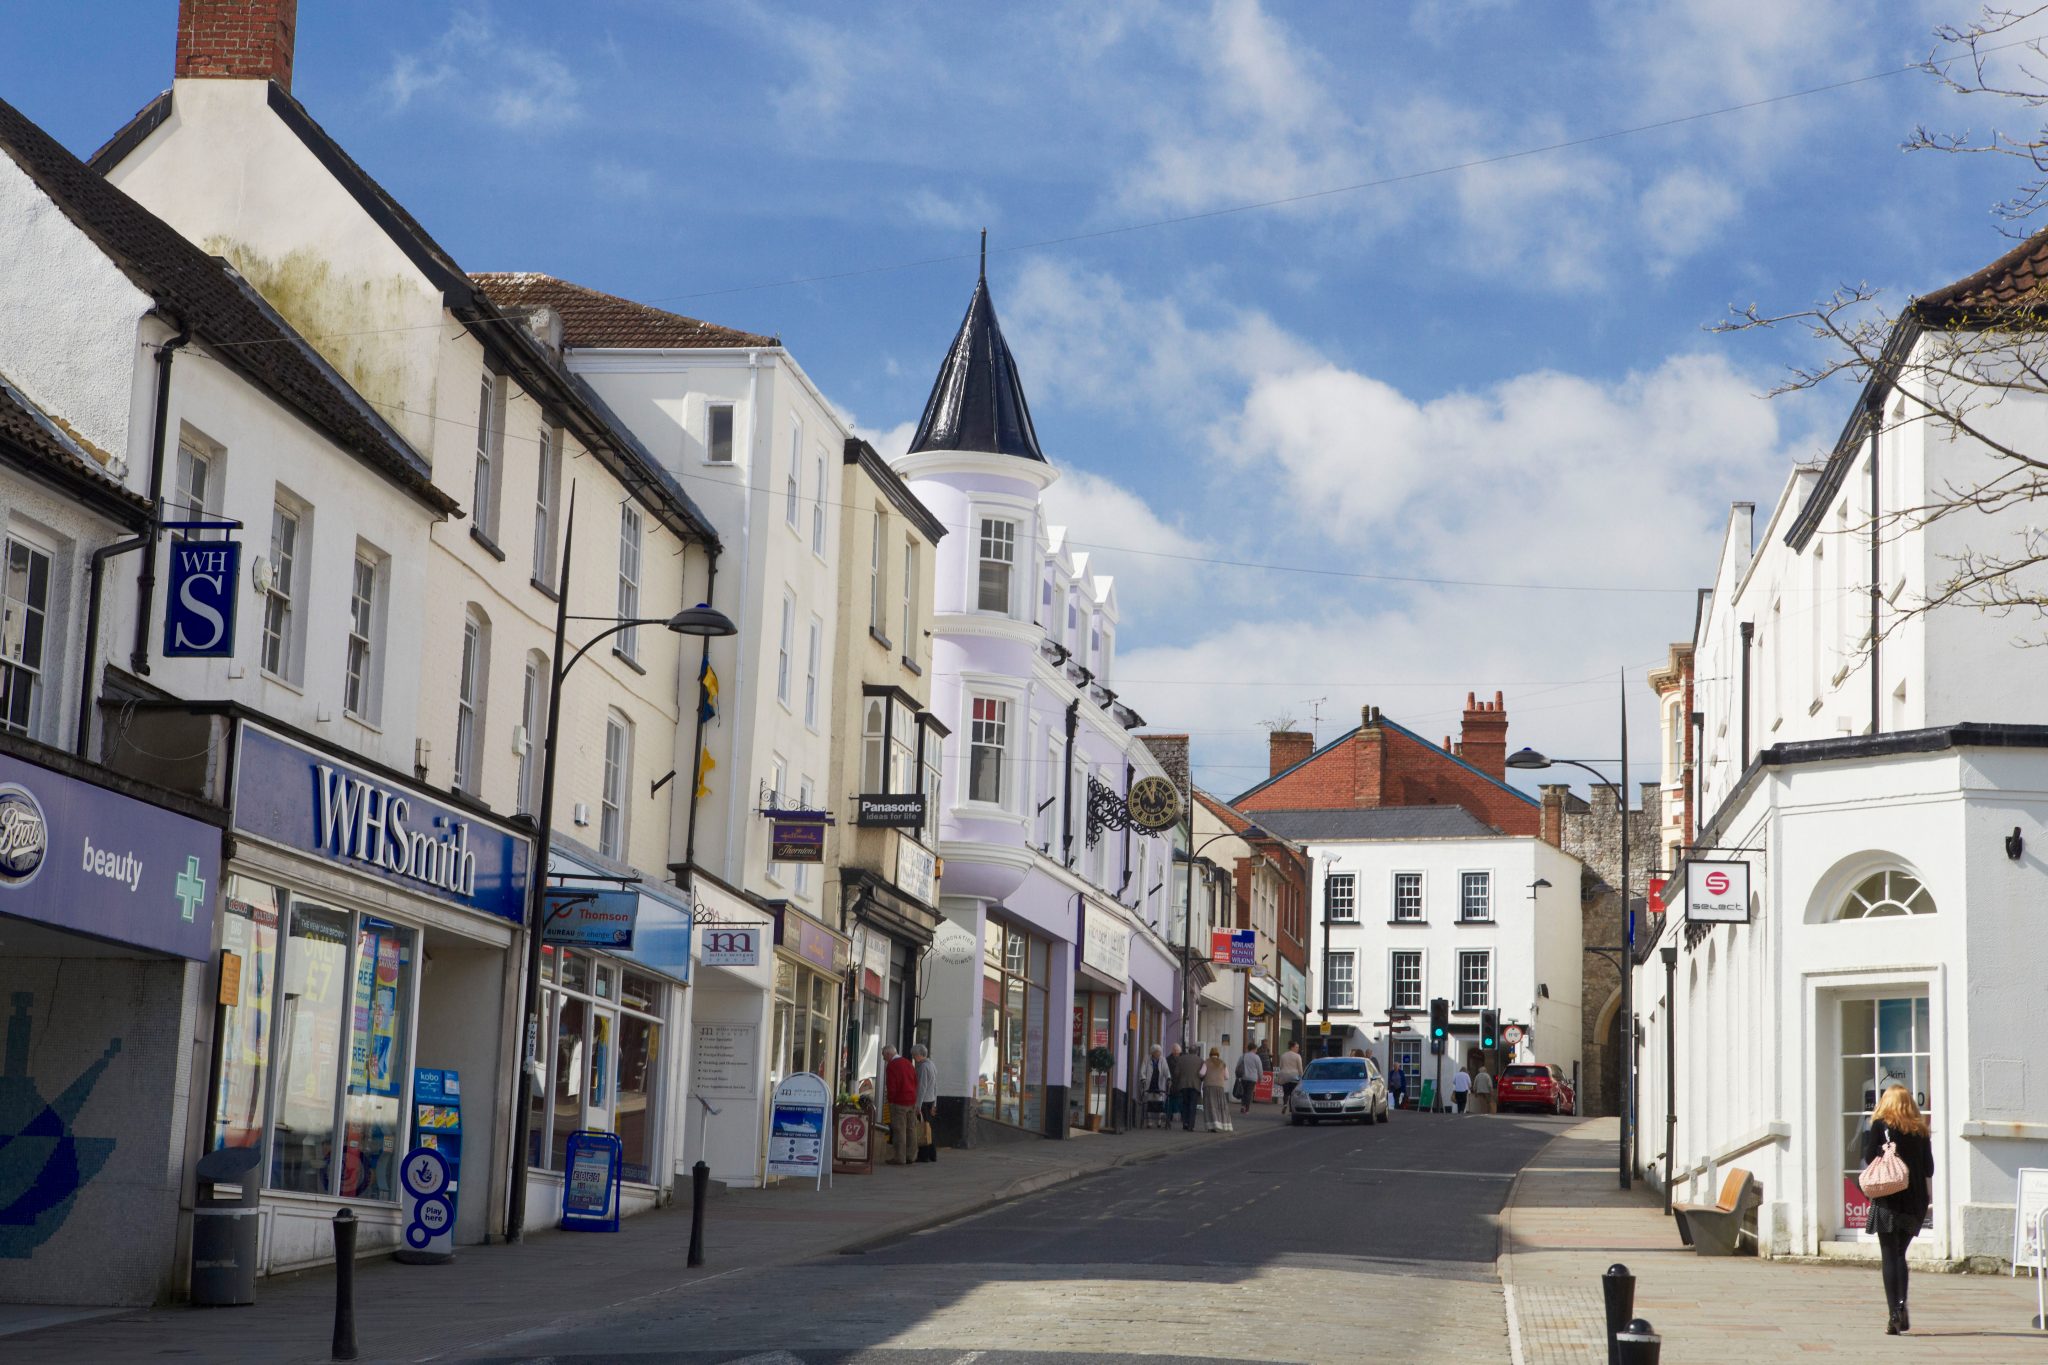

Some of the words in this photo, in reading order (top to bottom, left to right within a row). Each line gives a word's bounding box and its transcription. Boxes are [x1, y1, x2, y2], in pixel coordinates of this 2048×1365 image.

[180, 551, 228, 572] WH
[175, 573, 225, 650] S
[862, 801, 922, 812] Panasonic
[866, 812, 889, 820] ideas
[891, 812, 902, 820] for
[903, 812, 917, 820] life
[0, 807, 43, 858] Boots
[316, 765, 477, 897] WHSmith
[82, 836, 143, 892] beauty
[579, 908, 629, 921] Thomson
[547, 928, 575, 937] BUREAU
[940, 935, 975, 946] CORONATION
[1231, 941, 1255, 949] NEWLAND
[1231, 956, 1254, 964] WILKINS
[420, 1071, 439, 1082] kobo
[846, 1124, 861, 1137] £7
[426, 1206, 442, 1216] Play
[424, 1213, 443, 1223] here
